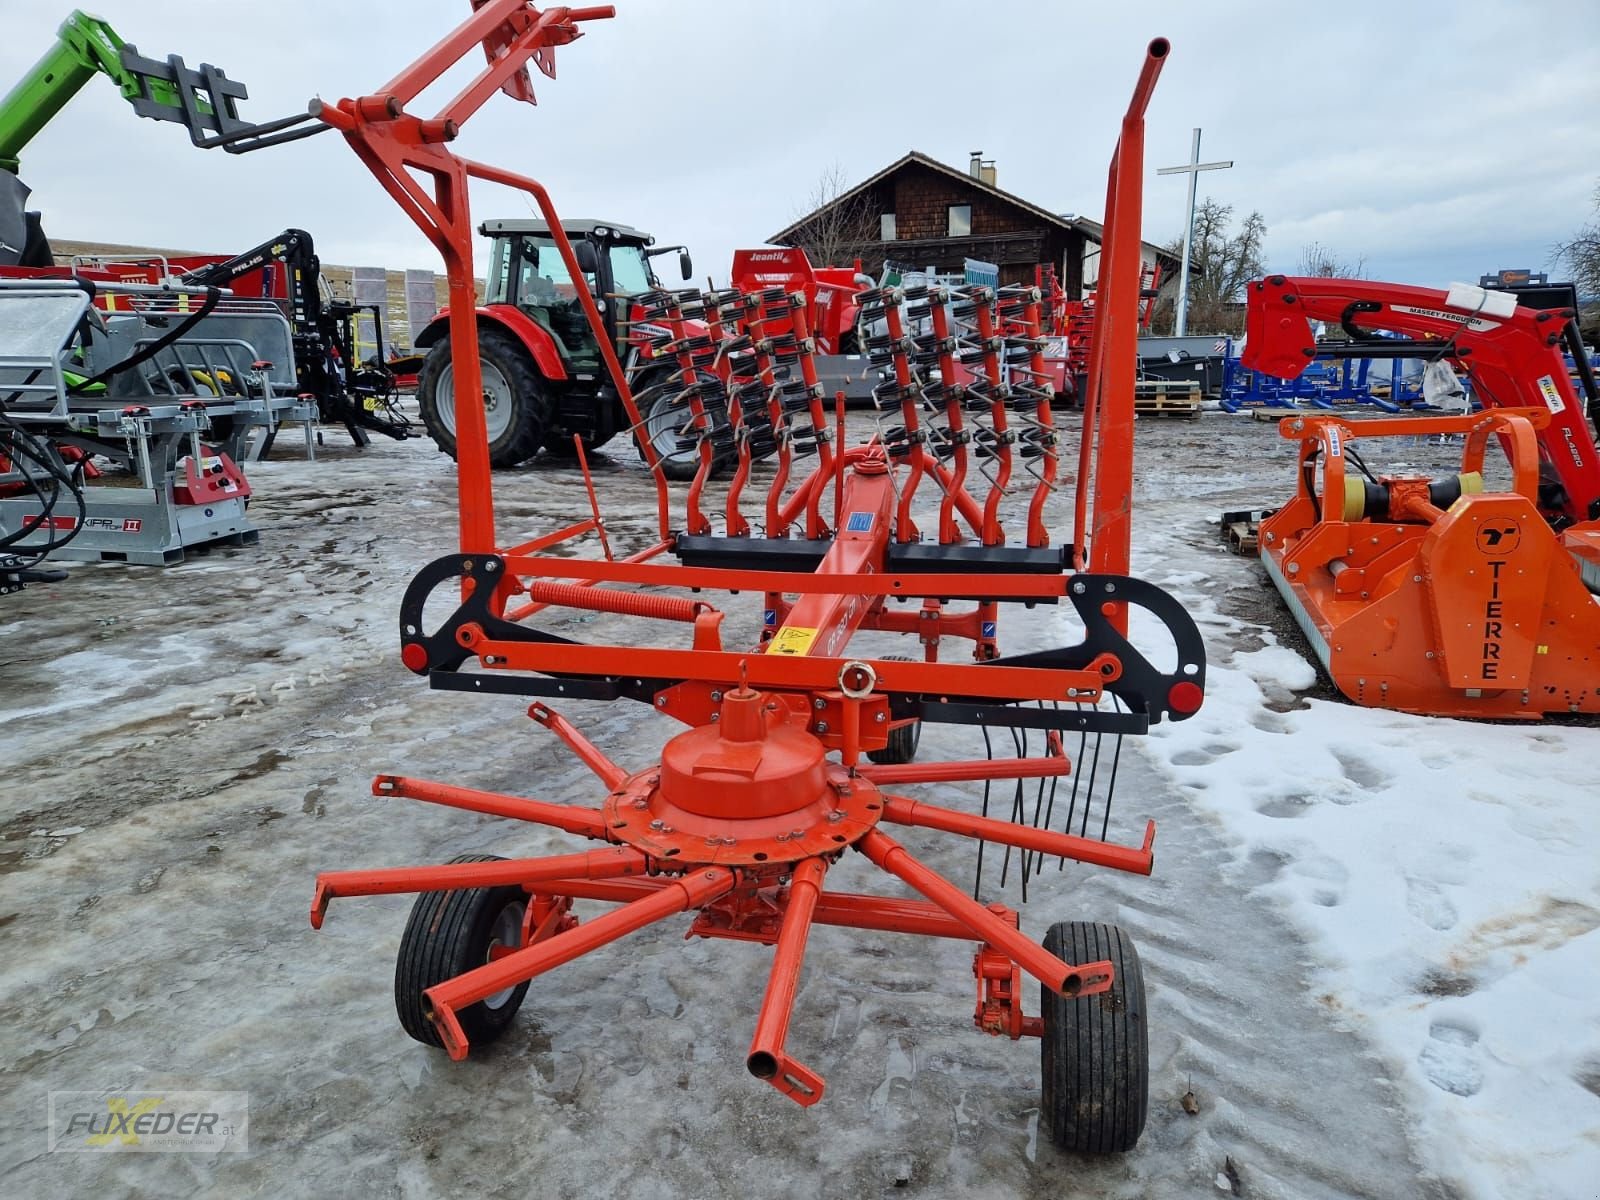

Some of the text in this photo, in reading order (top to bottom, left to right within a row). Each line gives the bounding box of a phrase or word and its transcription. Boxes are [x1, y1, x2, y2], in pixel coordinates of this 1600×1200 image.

[750, 252, 784, 262] Jeantil
[1409, 307, 1482, 326] MASSEY FERGUON
[1482, 561, 1507, 680] TIERRE
